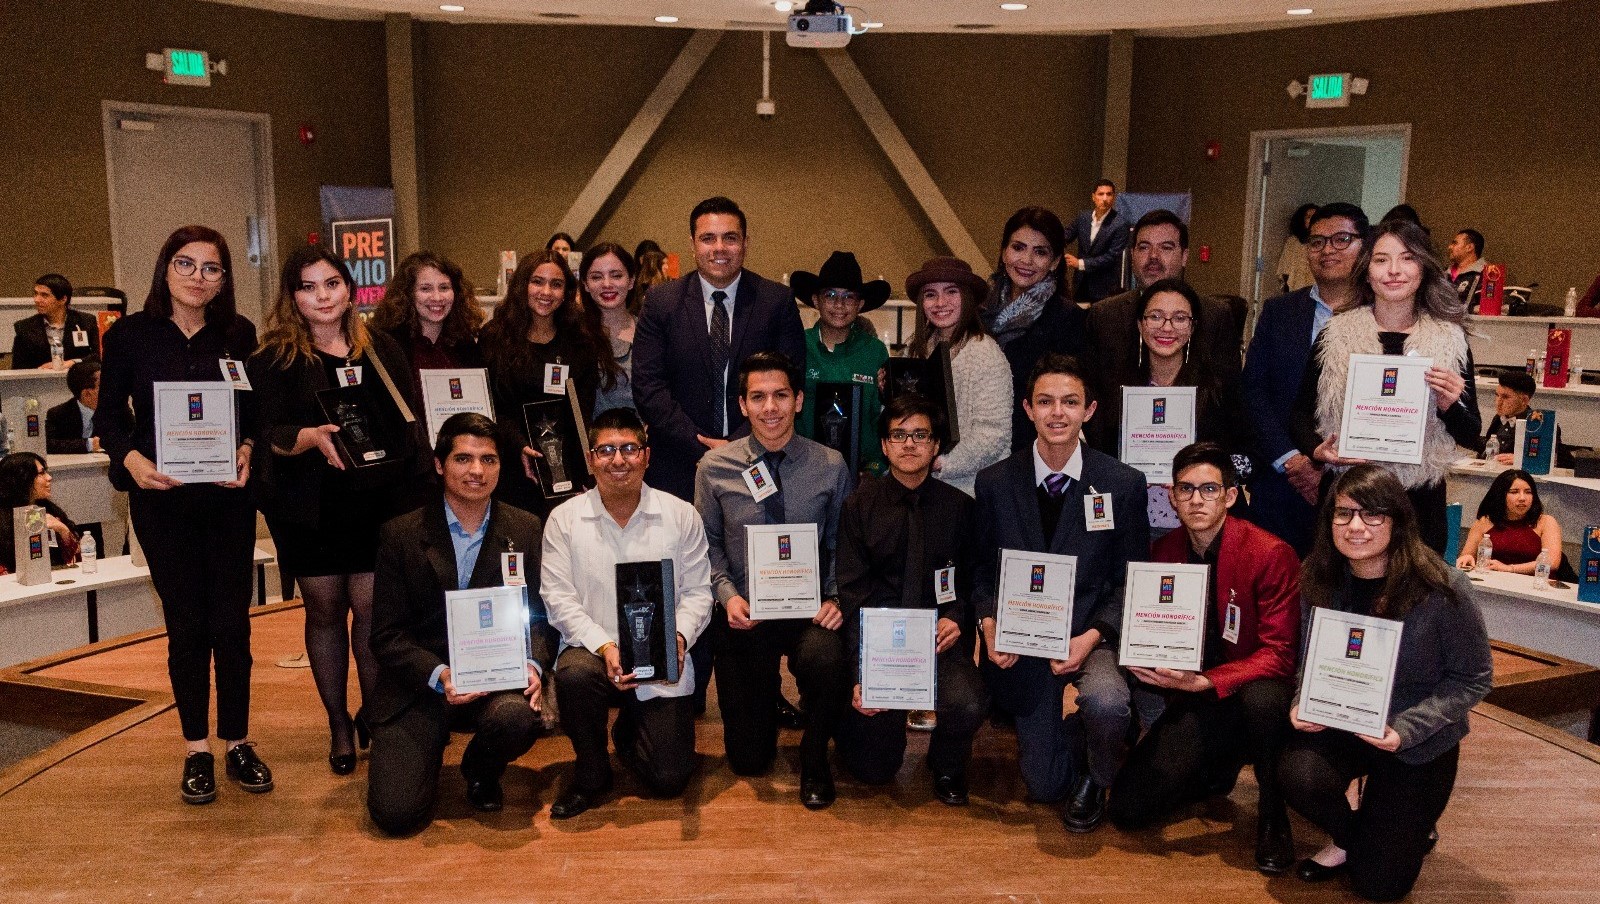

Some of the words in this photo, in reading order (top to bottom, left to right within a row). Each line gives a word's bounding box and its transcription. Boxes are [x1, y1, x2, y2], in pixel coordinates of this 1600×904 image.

[171, 50, 206, 77] SALIDA
[1311, 75, 1344, 99] SALIDA
[342, 229, 385, 259] PRE
[344, 259, 386, 286] MIO
[1383, 405, 1419, 414] HONORÍFICA
[1135, 611, 1160, 619] MENCIÓN
[1161, 612, 1195, 620] HONORÍFICA
